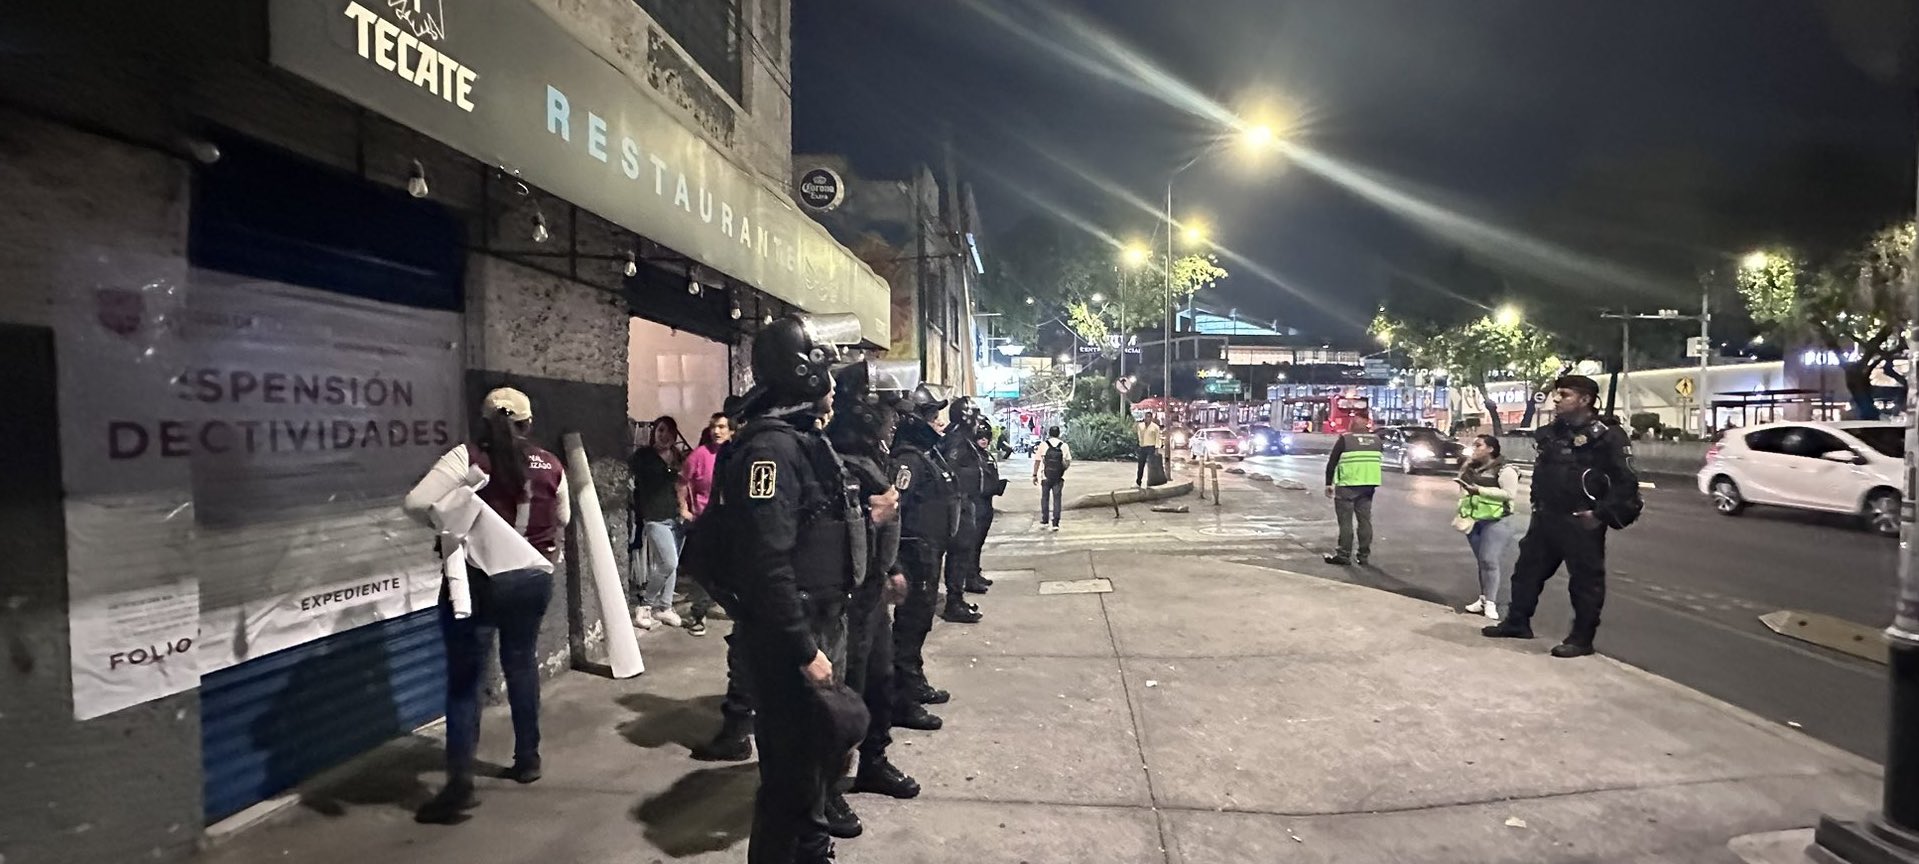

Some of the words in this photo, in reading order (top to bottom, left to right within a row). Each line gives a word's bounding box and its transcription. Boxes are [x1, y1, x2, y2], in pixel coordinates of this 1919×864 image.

[344, 1, 475, 112] TECATE
[547, 84, 795, 272] RESTAURANTE
[802, 183, 835, 194] Corona
[301, 578, 401, 611] EXPEDIENTE
[109, 637, 193, 669] FOLIO
